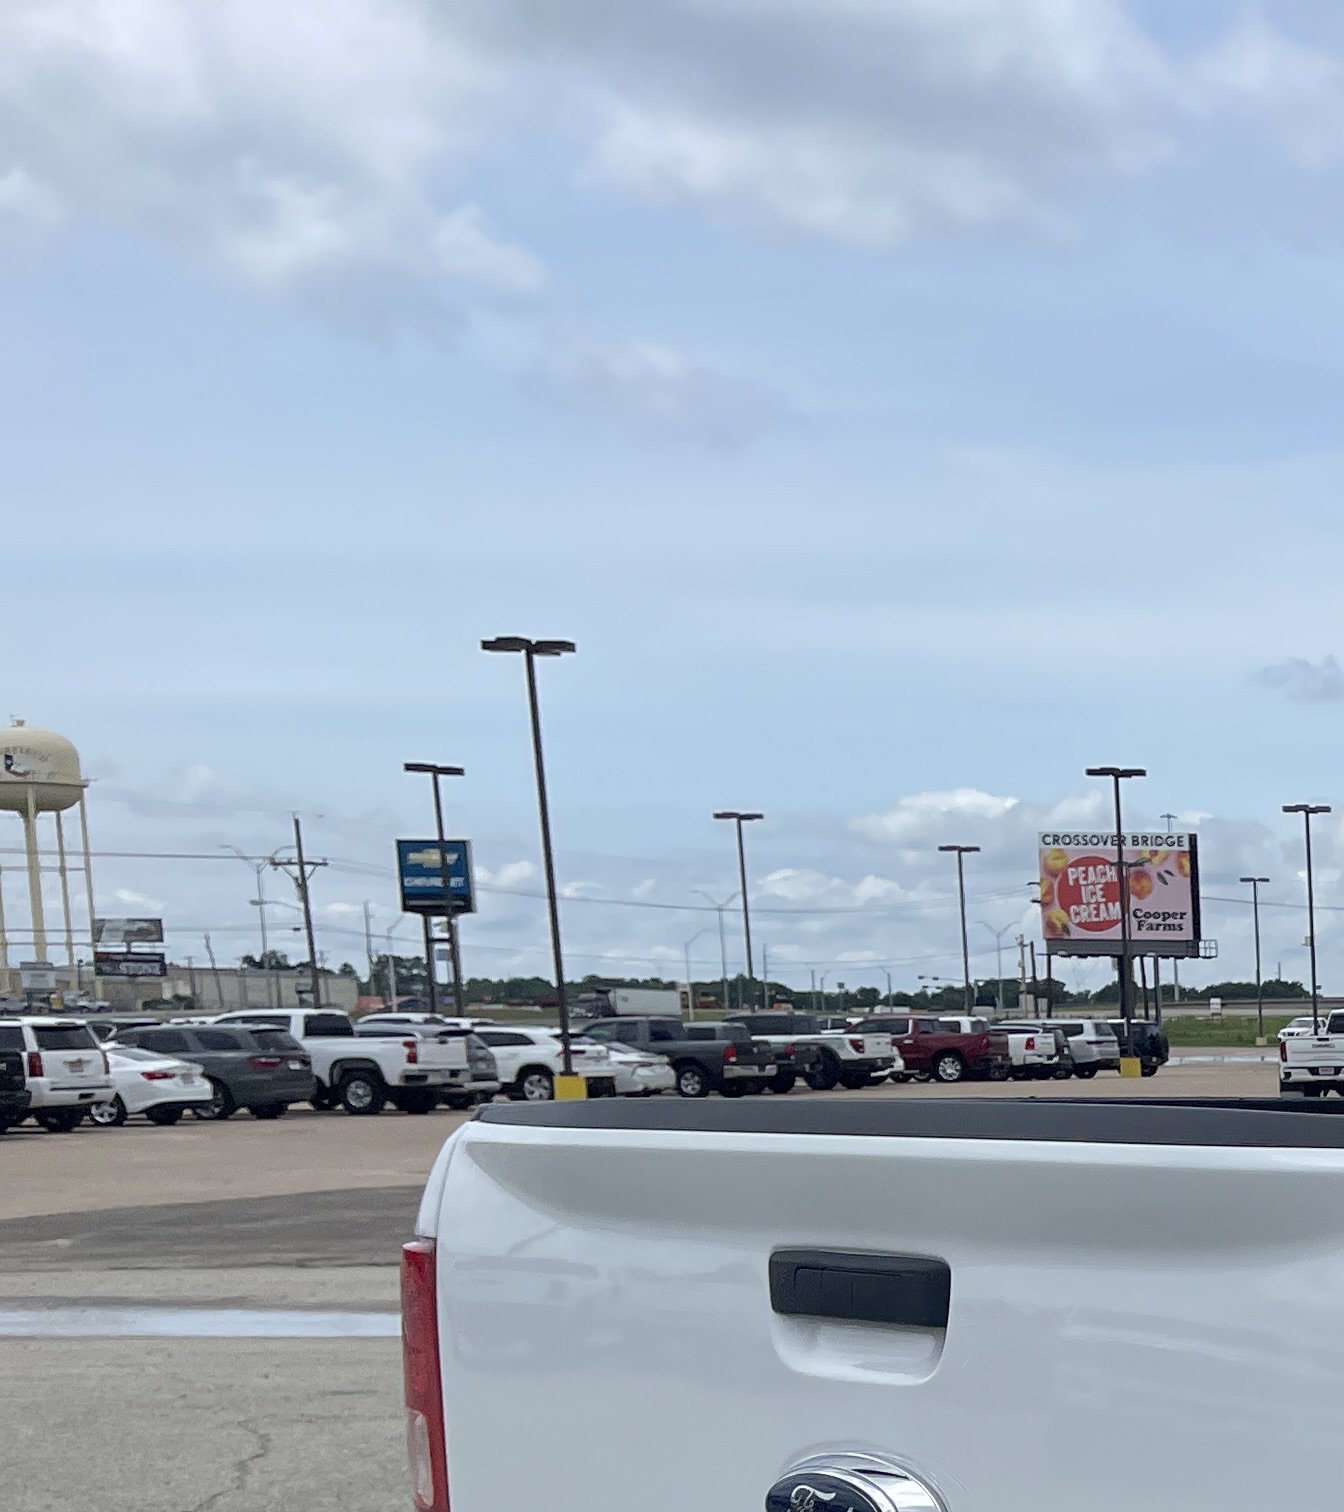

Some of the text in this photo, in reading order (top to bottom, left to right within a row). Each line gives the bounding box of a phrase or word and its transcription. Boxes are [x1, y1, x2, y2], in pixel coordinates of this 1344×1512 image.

[1042, 834, 1185, 848] CROSSOVER BRIDGE
[1067, 865, 1118, 886] PEACH
[1081, 884, 1106, 904] ICE
[1069, 902, 1121, 923] CREAM
[1132, 908, 1187, 921] Cooper
[1136, 919, 1185, 932] Farms
